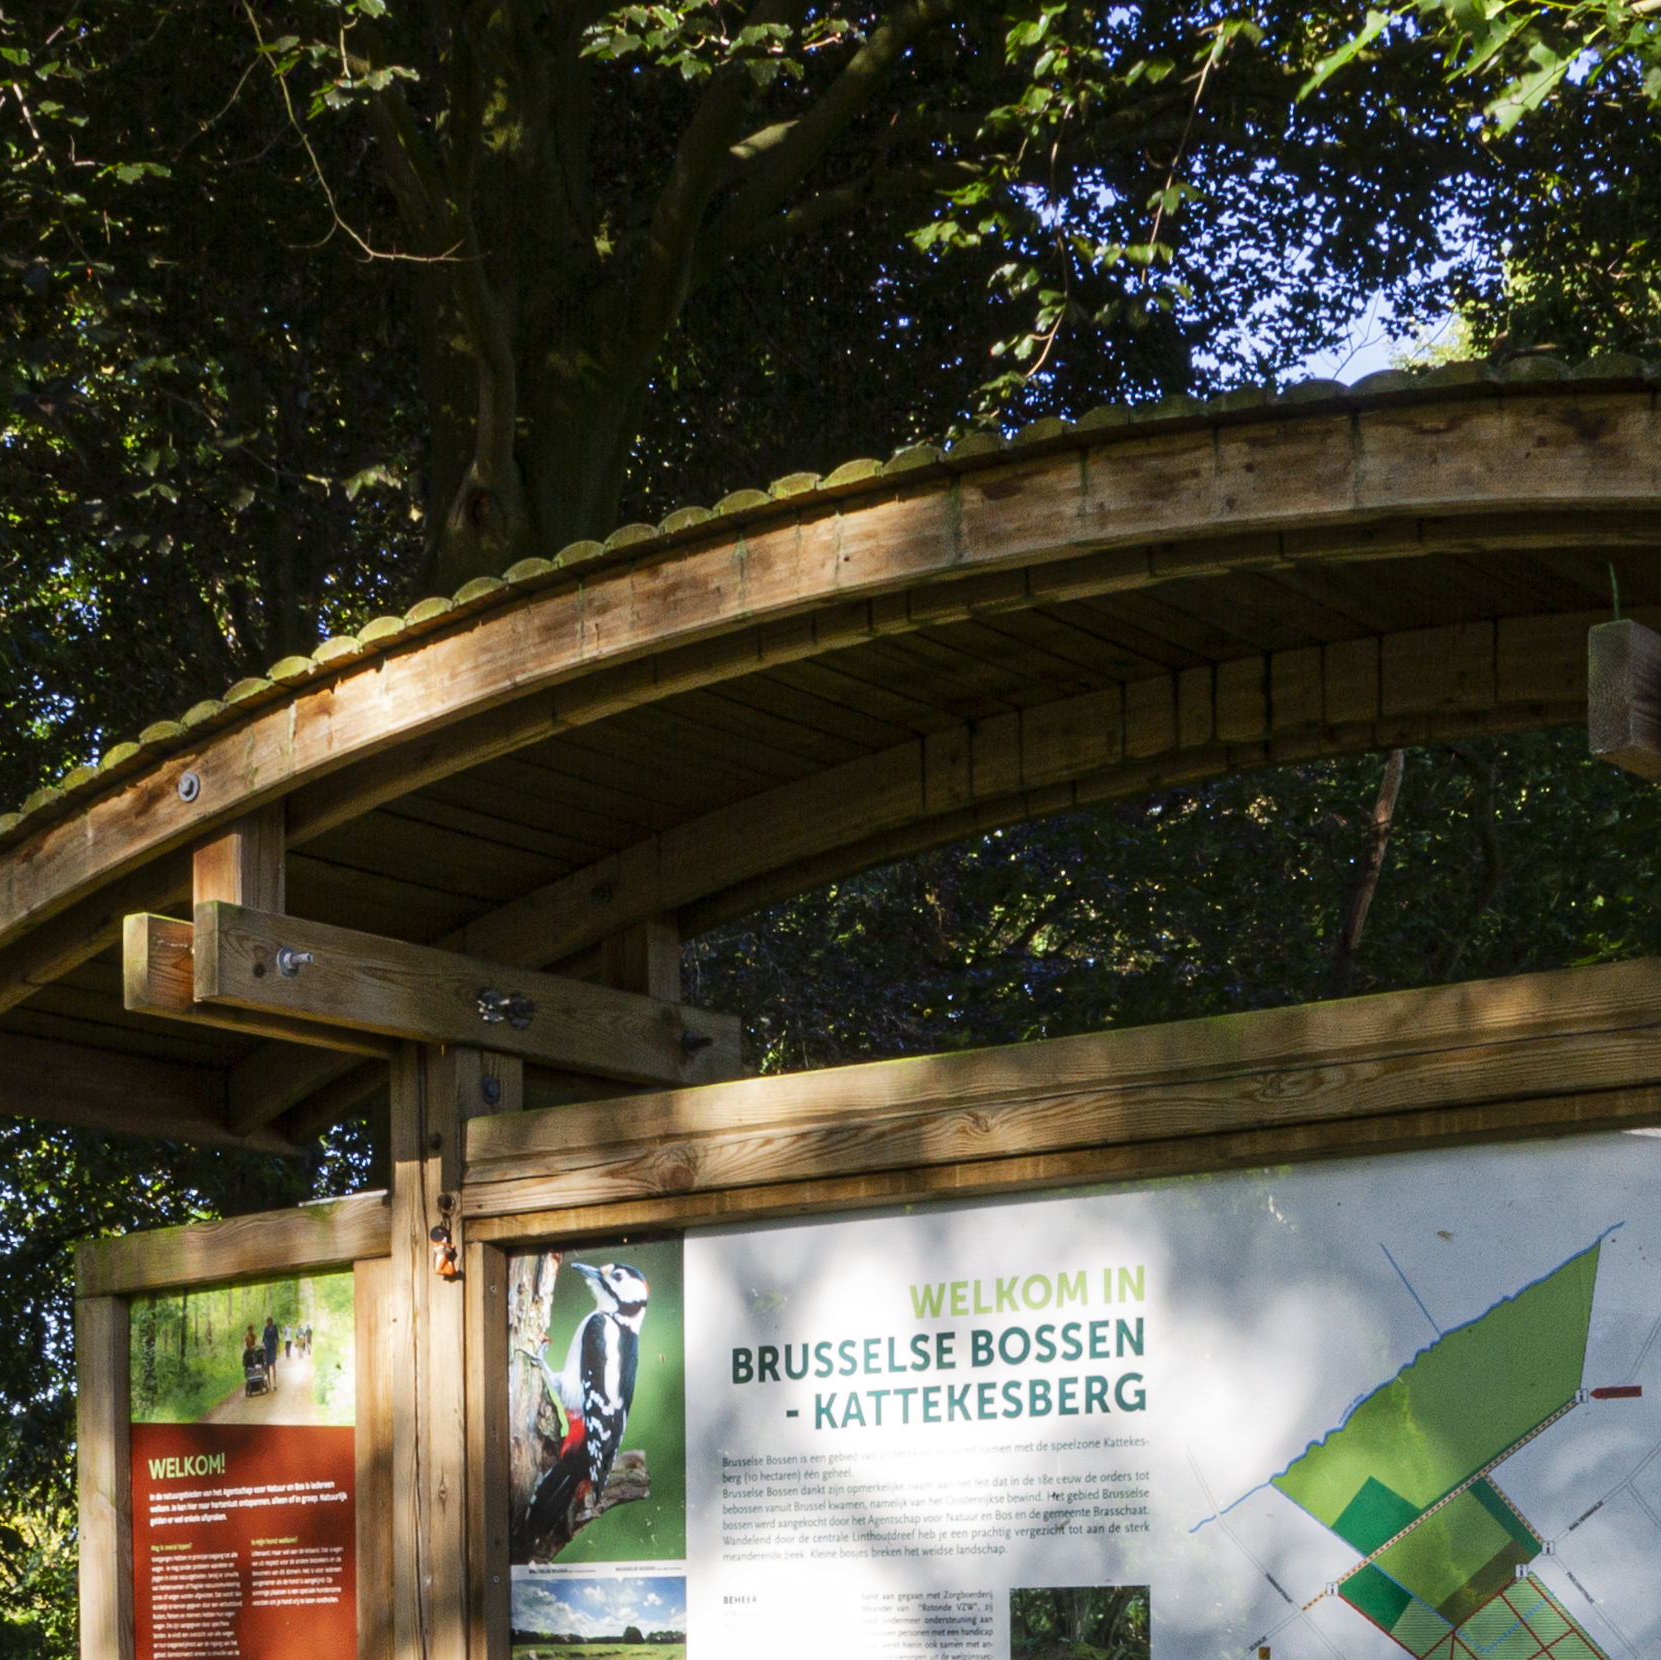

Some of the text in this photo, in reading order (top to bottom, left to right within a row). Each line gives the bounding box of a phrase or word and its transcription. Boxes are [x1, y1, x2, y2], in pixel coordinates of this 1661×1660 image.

[909, 1265, 1145, 1319] WELKOM IN
[732, 1317, 1144, 1385] BRUSSELSE BOSSEN
[815, 1372, 1146, 1430] KATTEKESBERG
[721, 1454, 764, 1467] Brusselse
[765, 1452, 798, 1465] Bossen
[800, 1454, 808, 1463] is
[810, 1454, 825, 1462] een
[828, 1450, 858, 1467] gebied
[1014, 1443, 1034, 1454] met
[1036, 1440, 1048, 1452] de
[1050, 1437, 1100, 1455] speelzone
[1103, 1435, 1149, 1448] Kattekes-
[148, 1452, 226, 1480] WELKOM!
[721, 1467, 853, 1487] berg (10 hectaren) één geheel.
[722, 1486, 764, 1499] Brusselse
[766, 1484, 799, 1497] Bossen
[799, 1483, 826, 1496] dankt
[827, 1482, 845, 1498] zijn
[846, 1480, 904, 1498] opmerkelijke
[991, 1475, 1008, 1487] dat
[1010, 1475, 1020, 1487] in
[1021, 1474, 1035, 1486] de
[1084, 1472, 1098, 1484] de
[1099, 1470, 1133, 1483] orders
[1134, 1469, 1150, 1481] tot
[721, 1487, 1150, 1515] bebossen vanuit Brussel kwamen, namelijk van het Oostenrijkse bewind. Het gebied Brusselse
[722, 1504, 1149, 1532] bossen werd aangekocht door het Agentschap voor Natuur en Bos en de gemeente Brasschaat.
[722, 1520, 1149, 1546] Wandelend door de centrale Linthoutdreef heb je een prachtig vergezicht tot aan de sterk
[810, 1547, 837, 1559] Kleine
[839, 1546, 868, 1563] bosjes
[870, 1546, 902, 1558] breken
[904, 1545, 920, 1557] het
[921, 1544, 954, 1557] weidse
[956, 1543, 1007, 1560] landschap.
